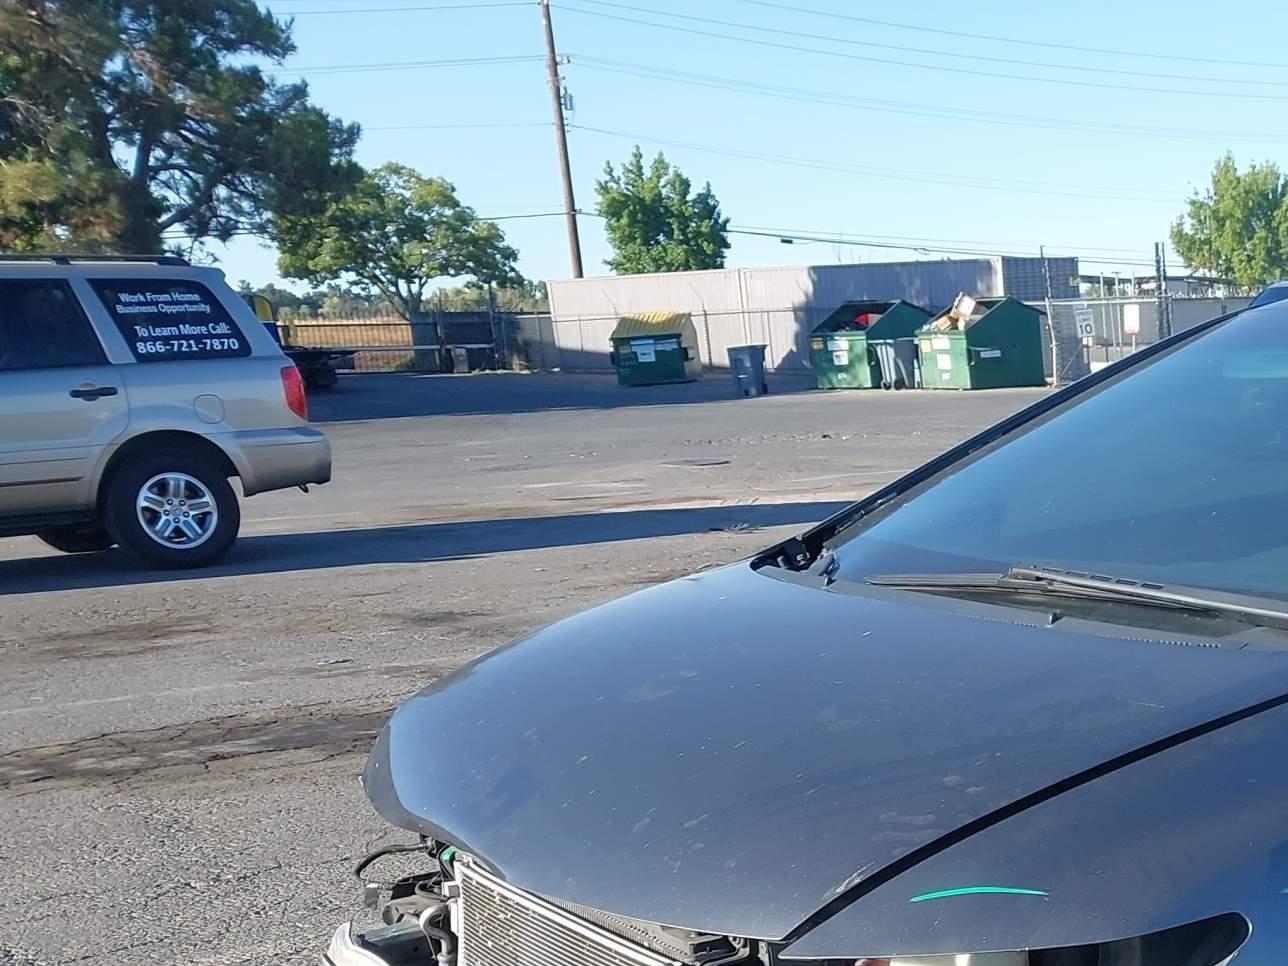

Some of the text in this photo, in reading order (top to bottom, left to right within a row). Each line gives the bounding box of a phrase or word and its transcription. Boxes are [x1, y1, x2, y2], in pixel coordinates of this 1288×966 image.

[118, 291, 201, 303] Work From Home
[115, 303, 211, 314] Business Opportunity
[134, 322, 232, 337] To Learn More Call:
[1079, 323, 1093, 335] 10
[135, 338, 239, 354] 866-721-7870
